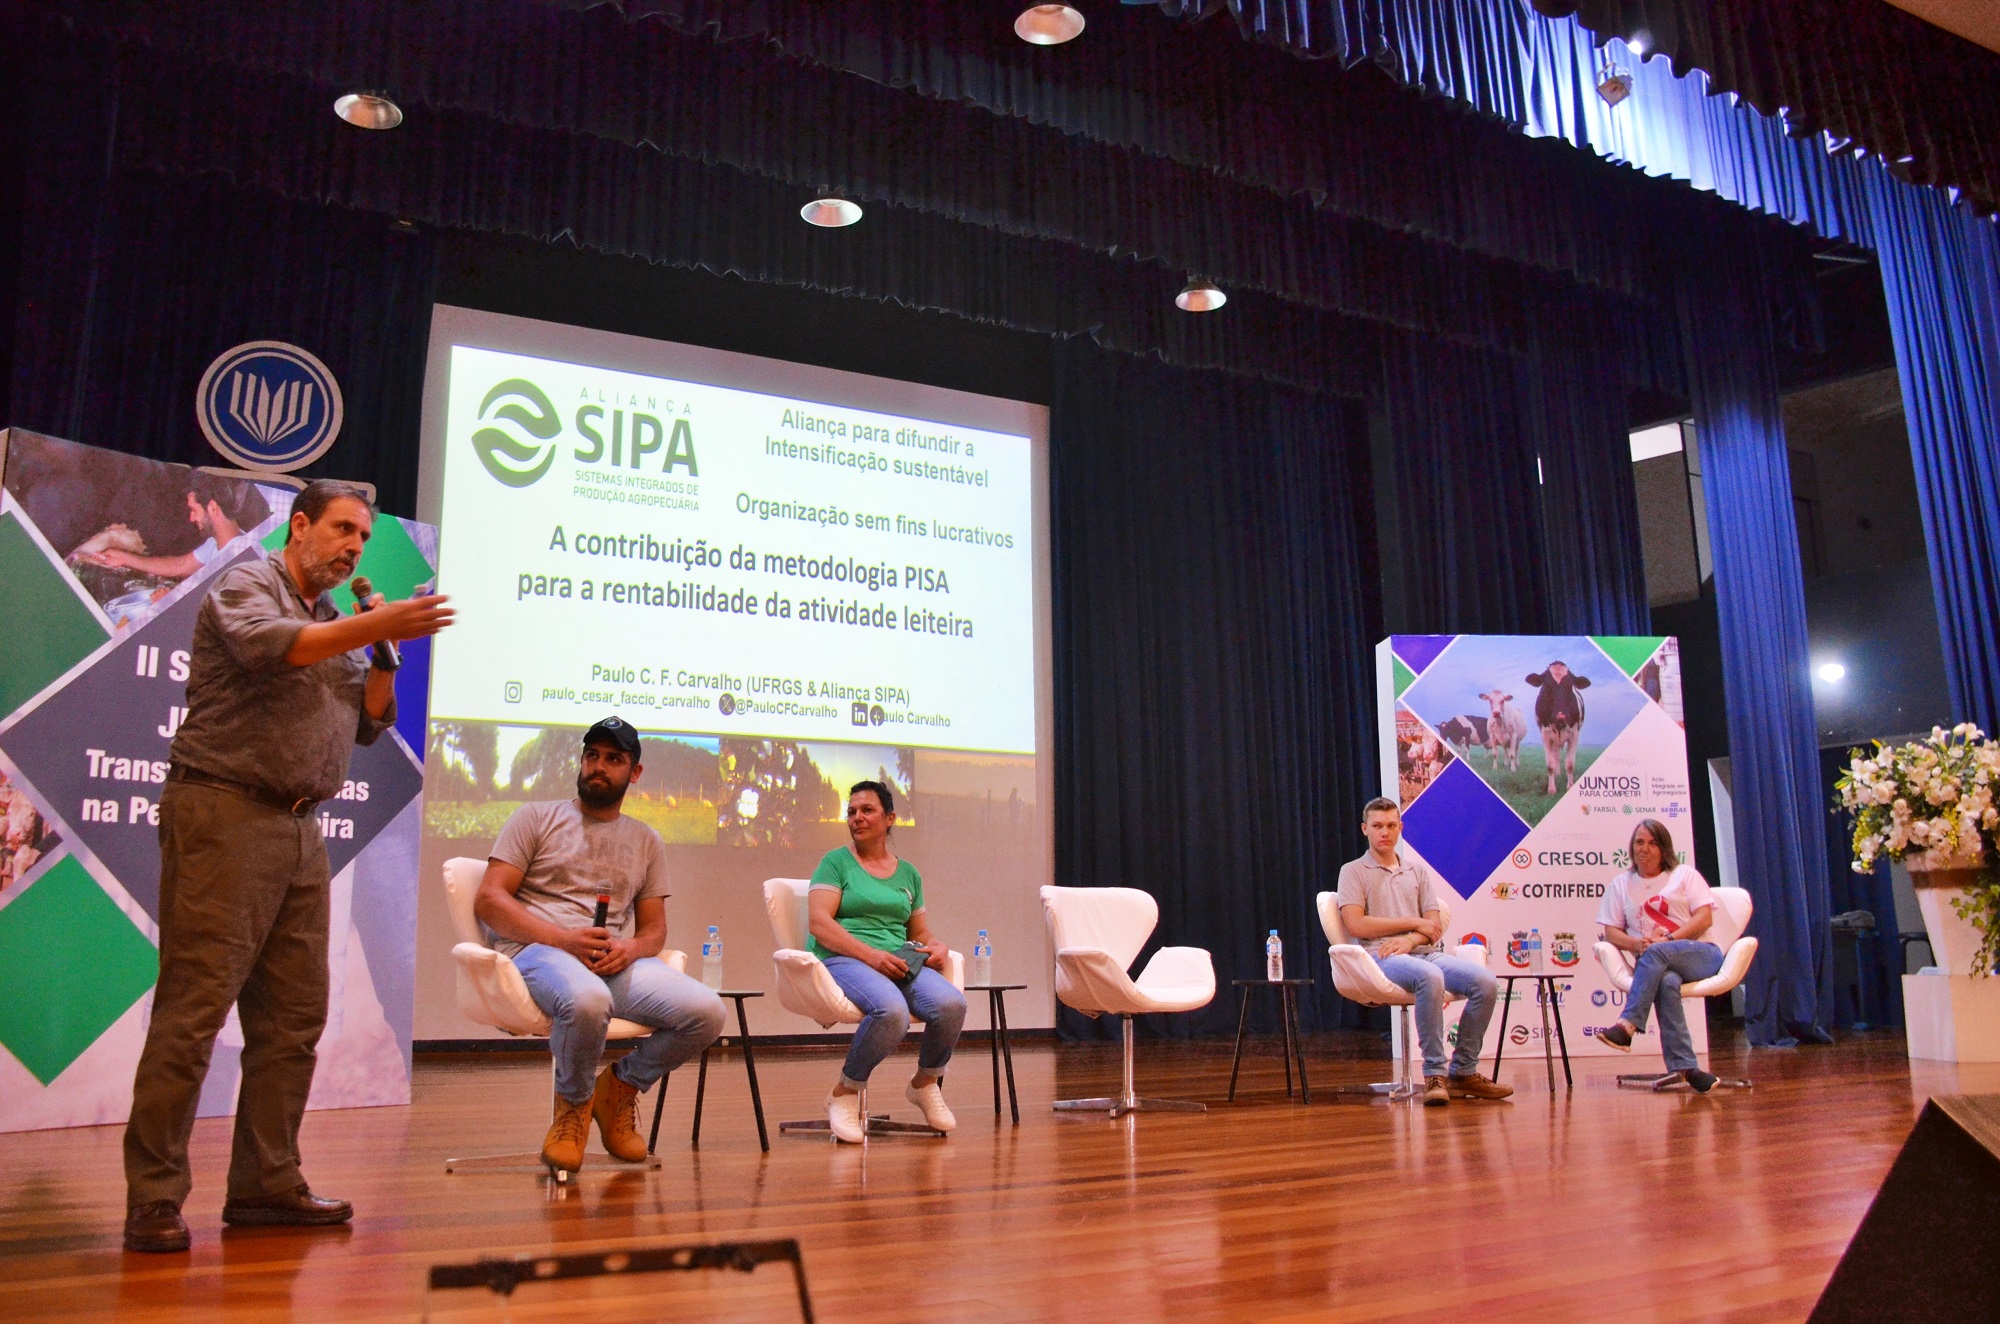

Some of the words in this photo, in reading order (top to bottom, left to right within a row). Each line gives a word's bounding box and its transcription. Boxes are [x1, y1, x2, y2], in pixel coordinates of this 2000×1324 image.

[580, 387, 691, 415] ALIANÇA
[574, 404, 699, 477] SIPA
[781, 408, 846, 439] Aliança
[852, 423, 890, 443] para
[895, 428, 960, 456] difundir
[965, 441, 974, 457] a
[765, 436, 888, 473] Intensificação
[893, 457, 989, 488] sustentável
[573, 486, 625, 504] PRODUÇÃO
[628, 492, 700, 511] AGROPECUÁRIA
[575, 470, 622, 486] SISTEMAS
[625, 476, 684, 494] INTEGRADOS
[687, 484, 699, 496] DE
[736, 492, 849, 528] Organização
[855, 511, 890, 532] sem
[896, 514, 927, 536] fins
[933, 520, 1014, 549] lucrativos
[549, 525, 567, 552] A
[574, 533, 722, 571] contribuição
[729, 544, 756, 571] da
[764, 554, 898, 591] metodologia
[905, 566, 950, 594] PISA
[517, 572, 572, 601] para
[580, 579, 594, 600] a
[602, 581, 758, 616] rentabilidade
[765, 591, 791, 619] da
[799, 597, 897, 629] atividade
[904, 606, 973, 638] leiteira
[592, 664, 635, 684] Paulo
[640, 668, 655, 685] C.
[660, 669, 672, 686] F.
[677, 671, 742, 691] Carvalho
[746, 675, 802, 696] (UFRGS
[807, 681, 817, 697] &
[820, 682, 870, 704] Aliança
[875, 687, 910, 708] SIPA)
[735, 699, 838, 718] @PauloCFCarvalho
[884, 711, 904, 723] aulo
[907, 712, 951, 727] Carvalho
[86, 749, 171, 784] Trans
[1579, 777, 1640, 790] JUNTOS
[82, 796, 118, 824] na
[1538, 851, 1609, 866] CRESOL
[1522, 884, 1605, 898] COTRIFRED
